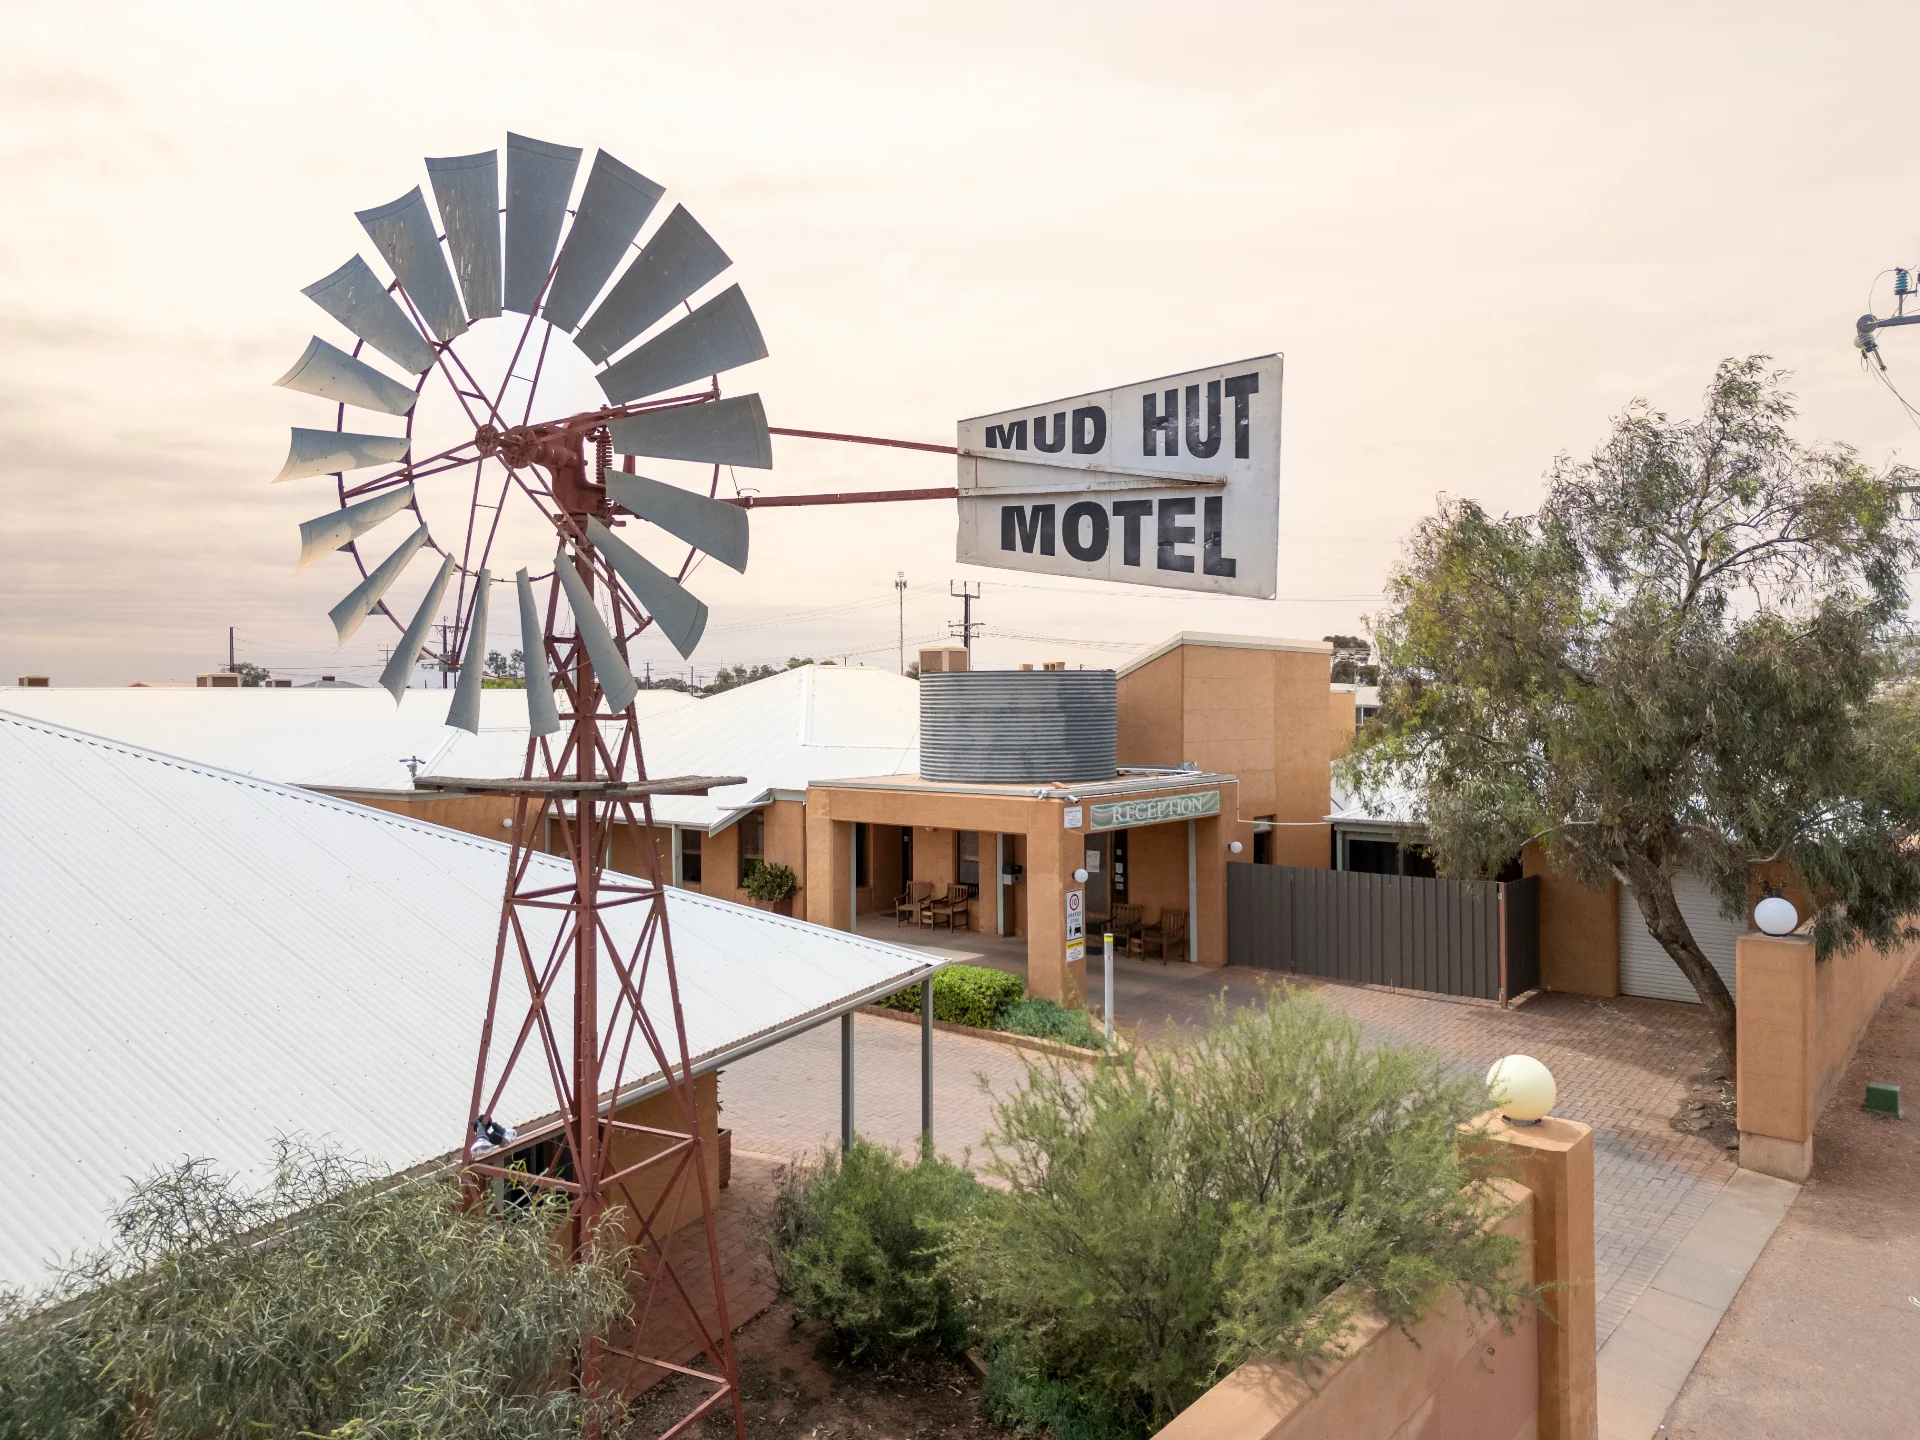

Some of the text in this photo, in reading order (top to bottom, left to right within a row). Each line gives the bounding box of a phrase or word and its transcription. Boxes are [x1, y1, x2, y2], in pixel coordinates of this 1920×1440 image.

[985, 372, 1259, 459] MUD HUT
[1001, 496, 1237, 578] MOTEL
[1112, 797, 1204, 823] RECEPTION
[1071, 898, 1077, 906] 10
